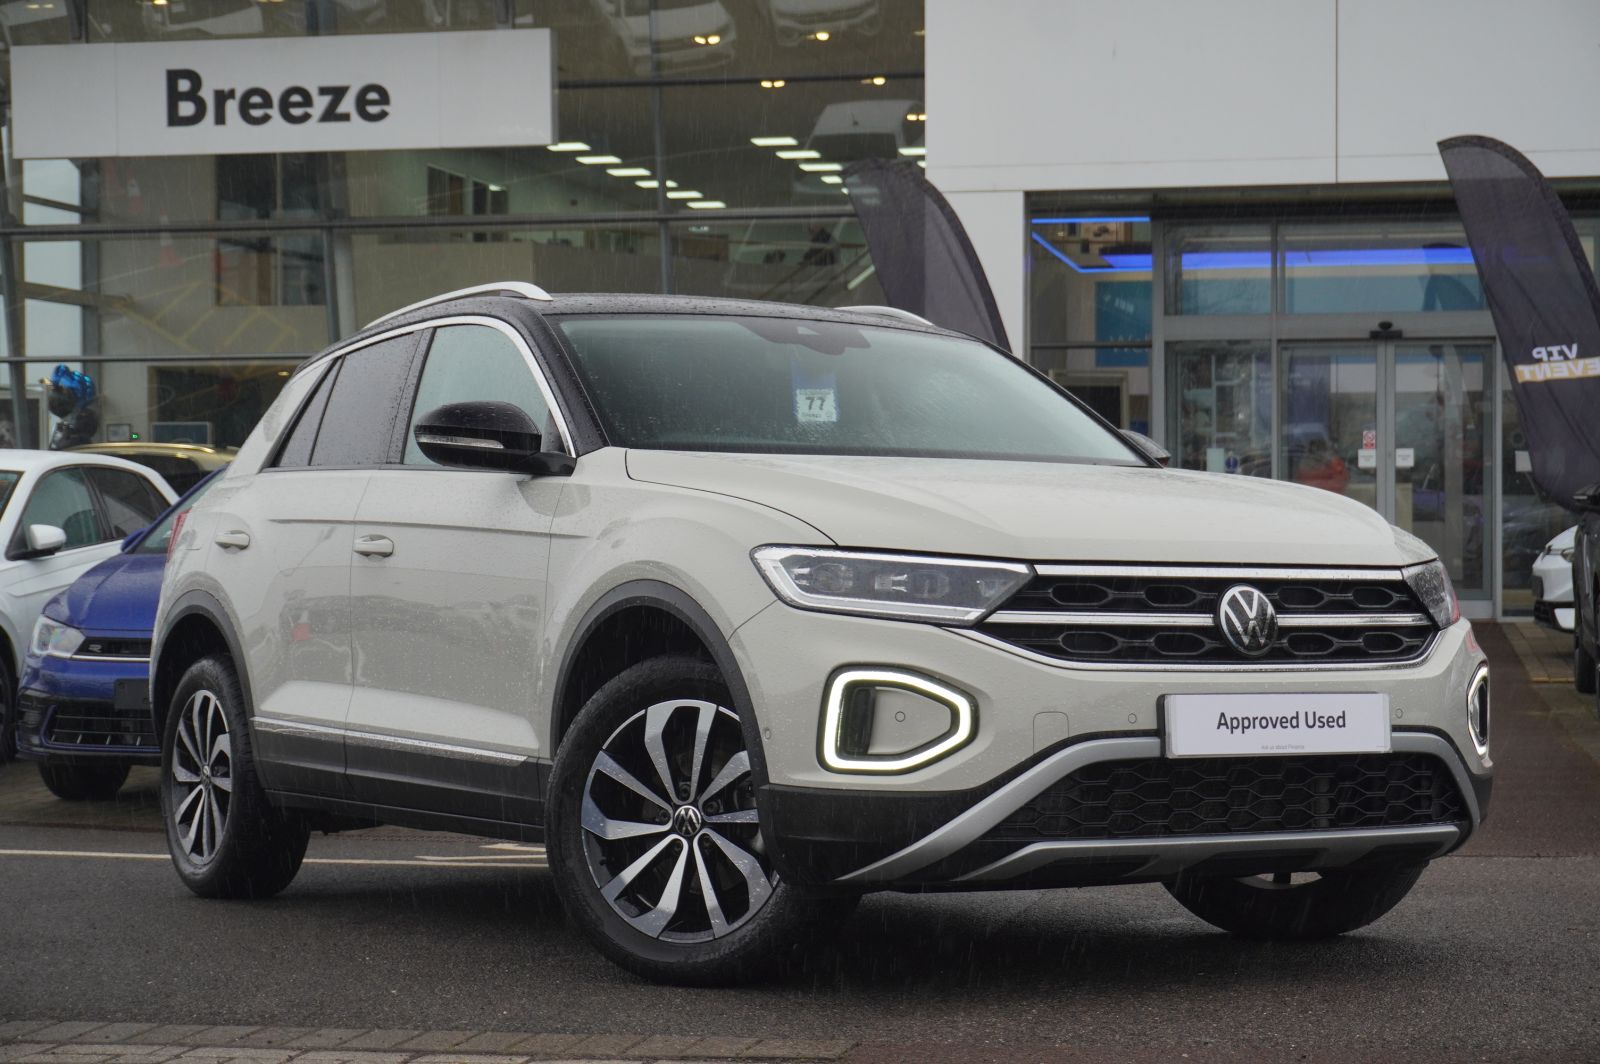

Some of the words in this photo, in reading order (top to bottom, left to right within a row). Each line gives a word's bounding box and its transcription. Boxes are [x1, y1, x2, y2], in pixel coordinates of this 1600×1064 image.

[166, 68, 390, 127] Breeze
[805, 396, 826, 411] 77
[1216, 711, 1300, 734] Approved
[1304, 710, 1346, 729] Used
